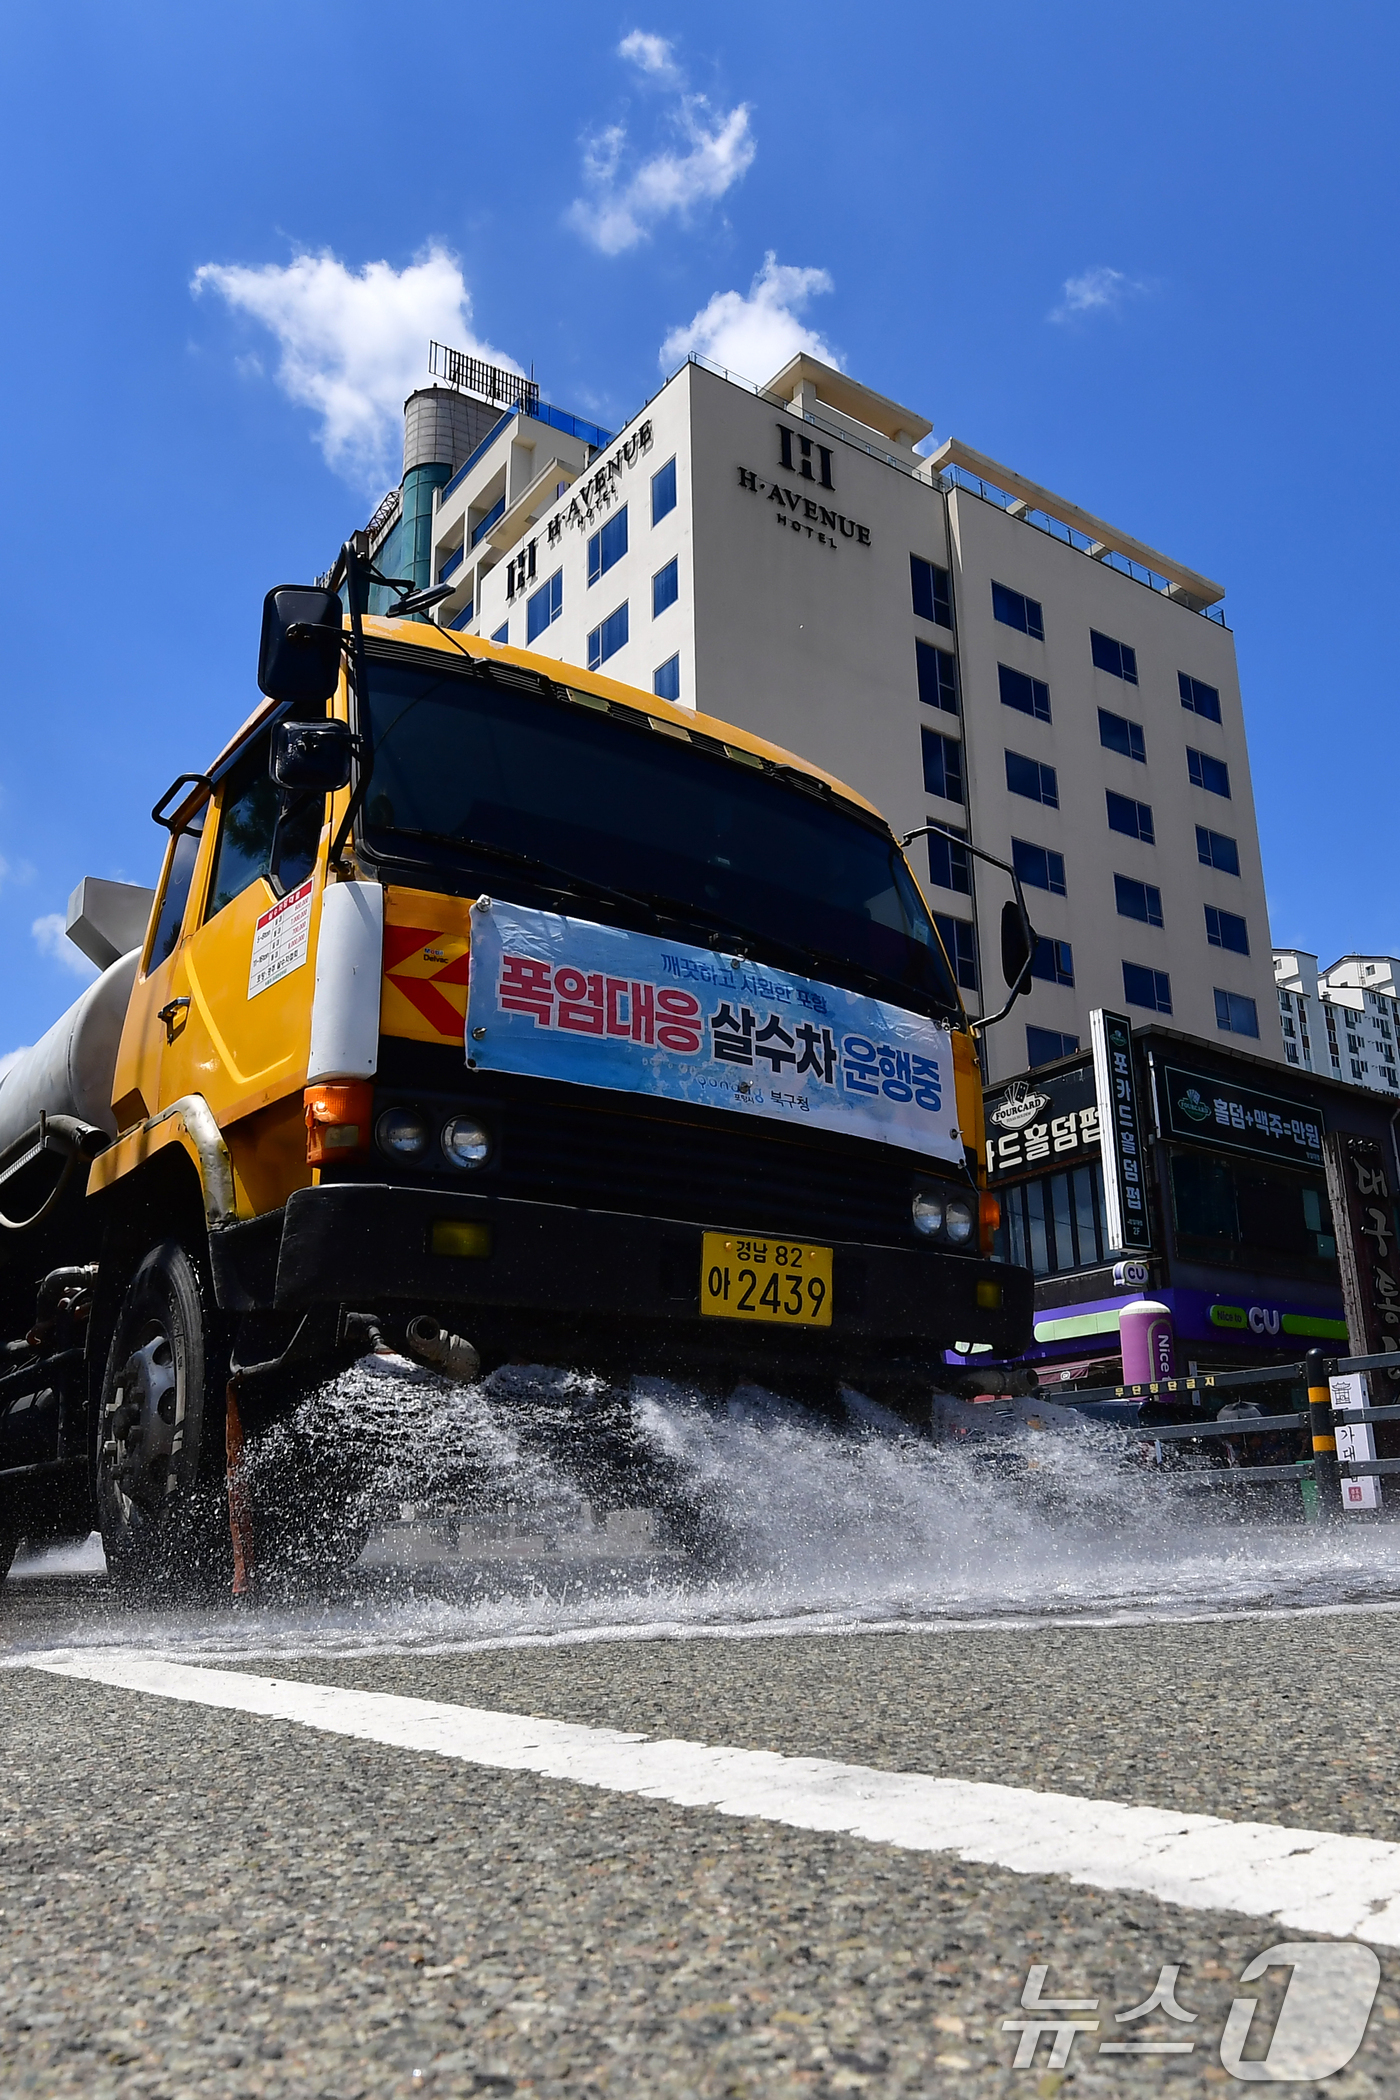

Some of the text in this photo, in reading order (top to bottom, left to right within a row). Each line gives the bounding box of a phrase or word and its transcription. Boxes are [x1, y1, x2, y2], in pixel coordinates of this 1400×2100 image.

[577, 484, 617, 528] HOTEL
[776, 512, 838, 549] HOTEL
[423, 954, 449, 964] Delvac
[660, 953, 828, 1015] 깨끗하고 시원한 포항
[499, 955, 943, 1113] 폭염대응 살수차 운행중
[770, 1090, 811, 1112] 북구청
[995, 1098, 1041, 1121] FOURCARD
[1213, 1098, 1321, 1149] 홀덤+맥주=만원
[736, 1240, 803, 1268] 경남 82
[1127, 1267, 1145, 1280] CU
[1216, 1306, 1280, 1335] Nice to CU
[1158, 1334, 1171, 1373] Nice
